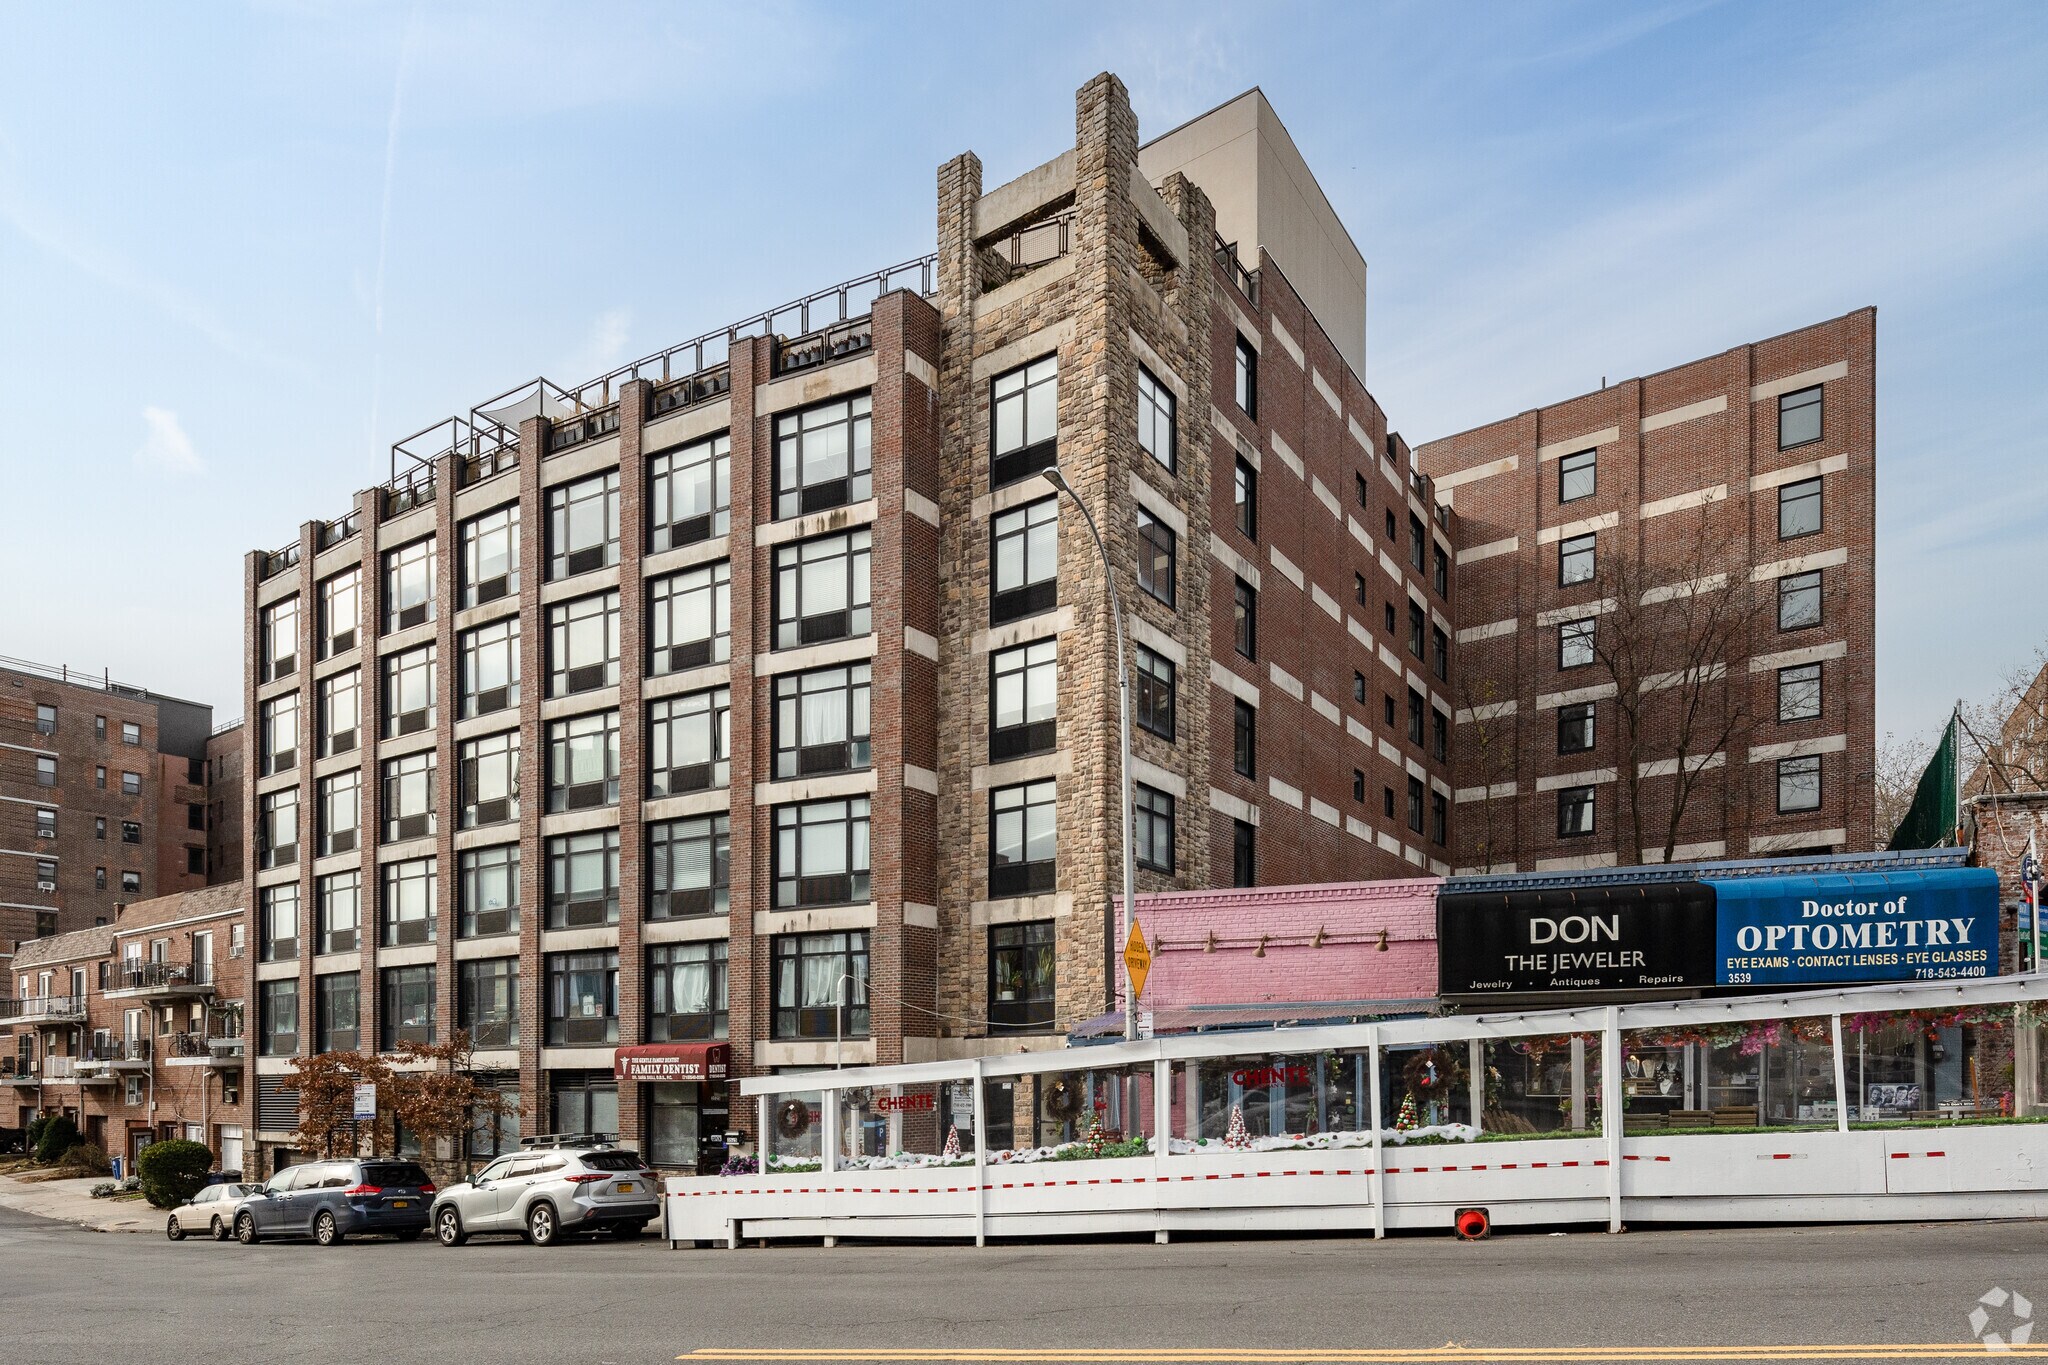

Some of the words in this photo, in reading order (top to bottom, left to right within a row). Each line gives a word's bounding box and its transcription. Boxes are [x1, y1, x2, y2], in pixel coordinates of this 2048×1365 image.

[1802, 899, 1879, 918] Doctor
[1883, 896, 1908, 915] of
[1529, 914, 1620, 945] DON
[1736, 917, 1976, 952] OPTOMETRY
[1504, 953, 1547, 971] THE
[1550, 950, 1646, 974] JEWELER
[1727, 957, 1749, 969] EYE
[1751, 956, 1789, 969] EXAMS
[1797, 954, 1851, 967] CONTACT
[1852, 953, 1899, 966] LENSES
[1906, 951, 1930, 964] EYE
[1931, 949, 1988, 963] GLASSES
[1469, 979, 1513, 990] Jewelry
[1550, 977, 1601, 987] Antiques
[1639, 974, 1684, 985] Repairs
[1728, 973, 1752, 983] 3539
[1915, 966, 1986, 979] 718-543-4400
[631, 1064, 661, 1074] FAMILY
[662, 1064, 700, 1074] DENTIST
[709, 1064, 726, 1073] DENTIST
[1232, 1066, 1310, 1086] CHENTE
[878, 1092, 934, 1110] CHENTE
